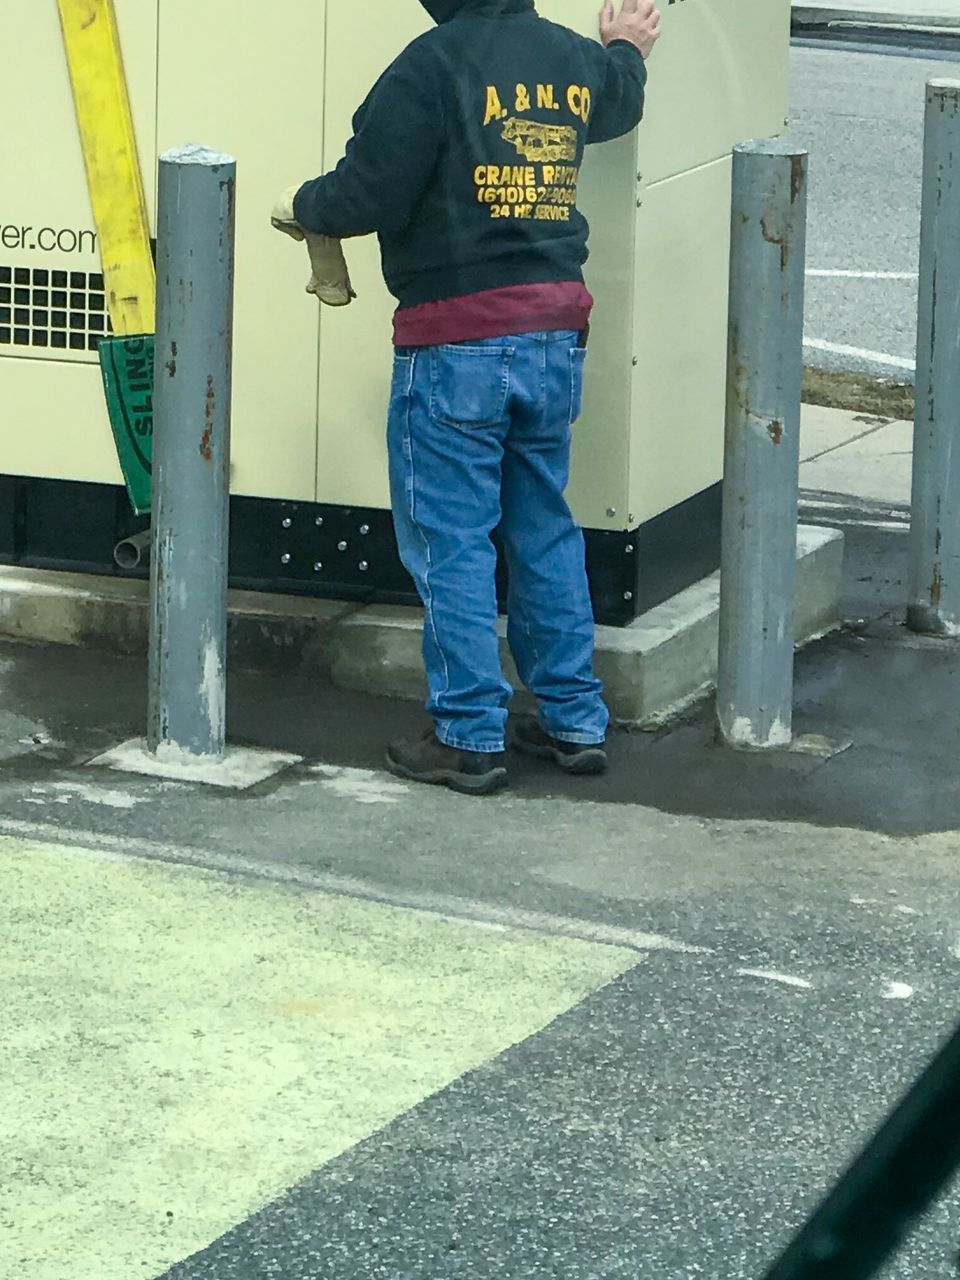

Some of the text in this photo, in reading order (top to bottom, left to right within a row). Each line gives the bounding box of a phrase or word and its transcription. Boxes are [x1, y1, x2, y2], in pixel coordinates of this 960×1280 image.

[483, 85, 508, 126] A.
[514, 83, 531, 112] &
[536, 84, 560, 110] N.
[473, 165, 536, 186] CRANE
[490, 204, 511, 218] 24
